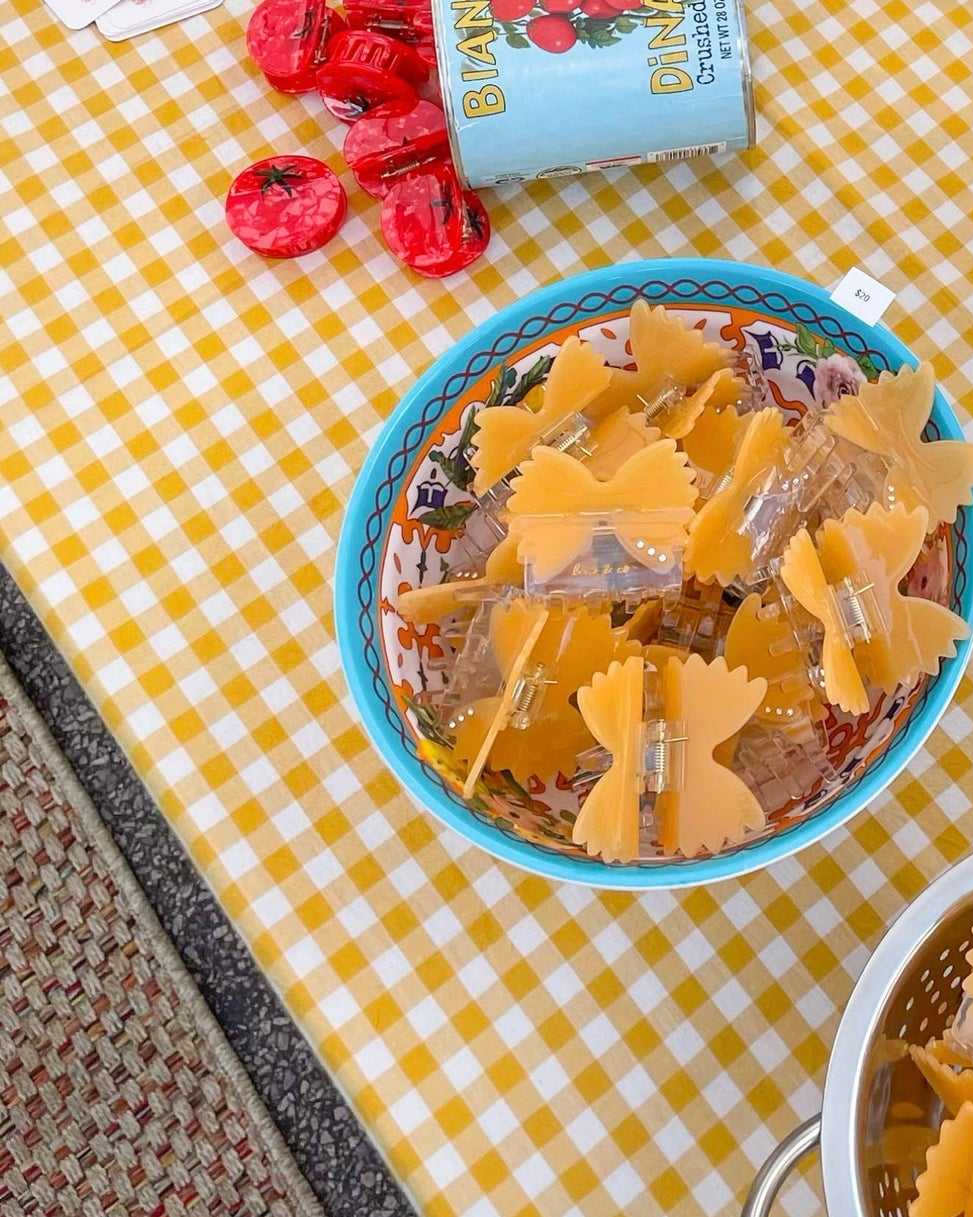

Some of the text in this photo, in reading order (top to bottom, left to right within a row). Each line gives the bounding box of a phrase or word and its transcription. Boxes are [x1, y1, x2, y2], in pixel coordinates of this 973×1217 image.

[715, 11, 729, 23] 28
[717, 25, 730, 43] WT
[719, 44, 732, 60] NET
[854, 288, 871, 303] $20
